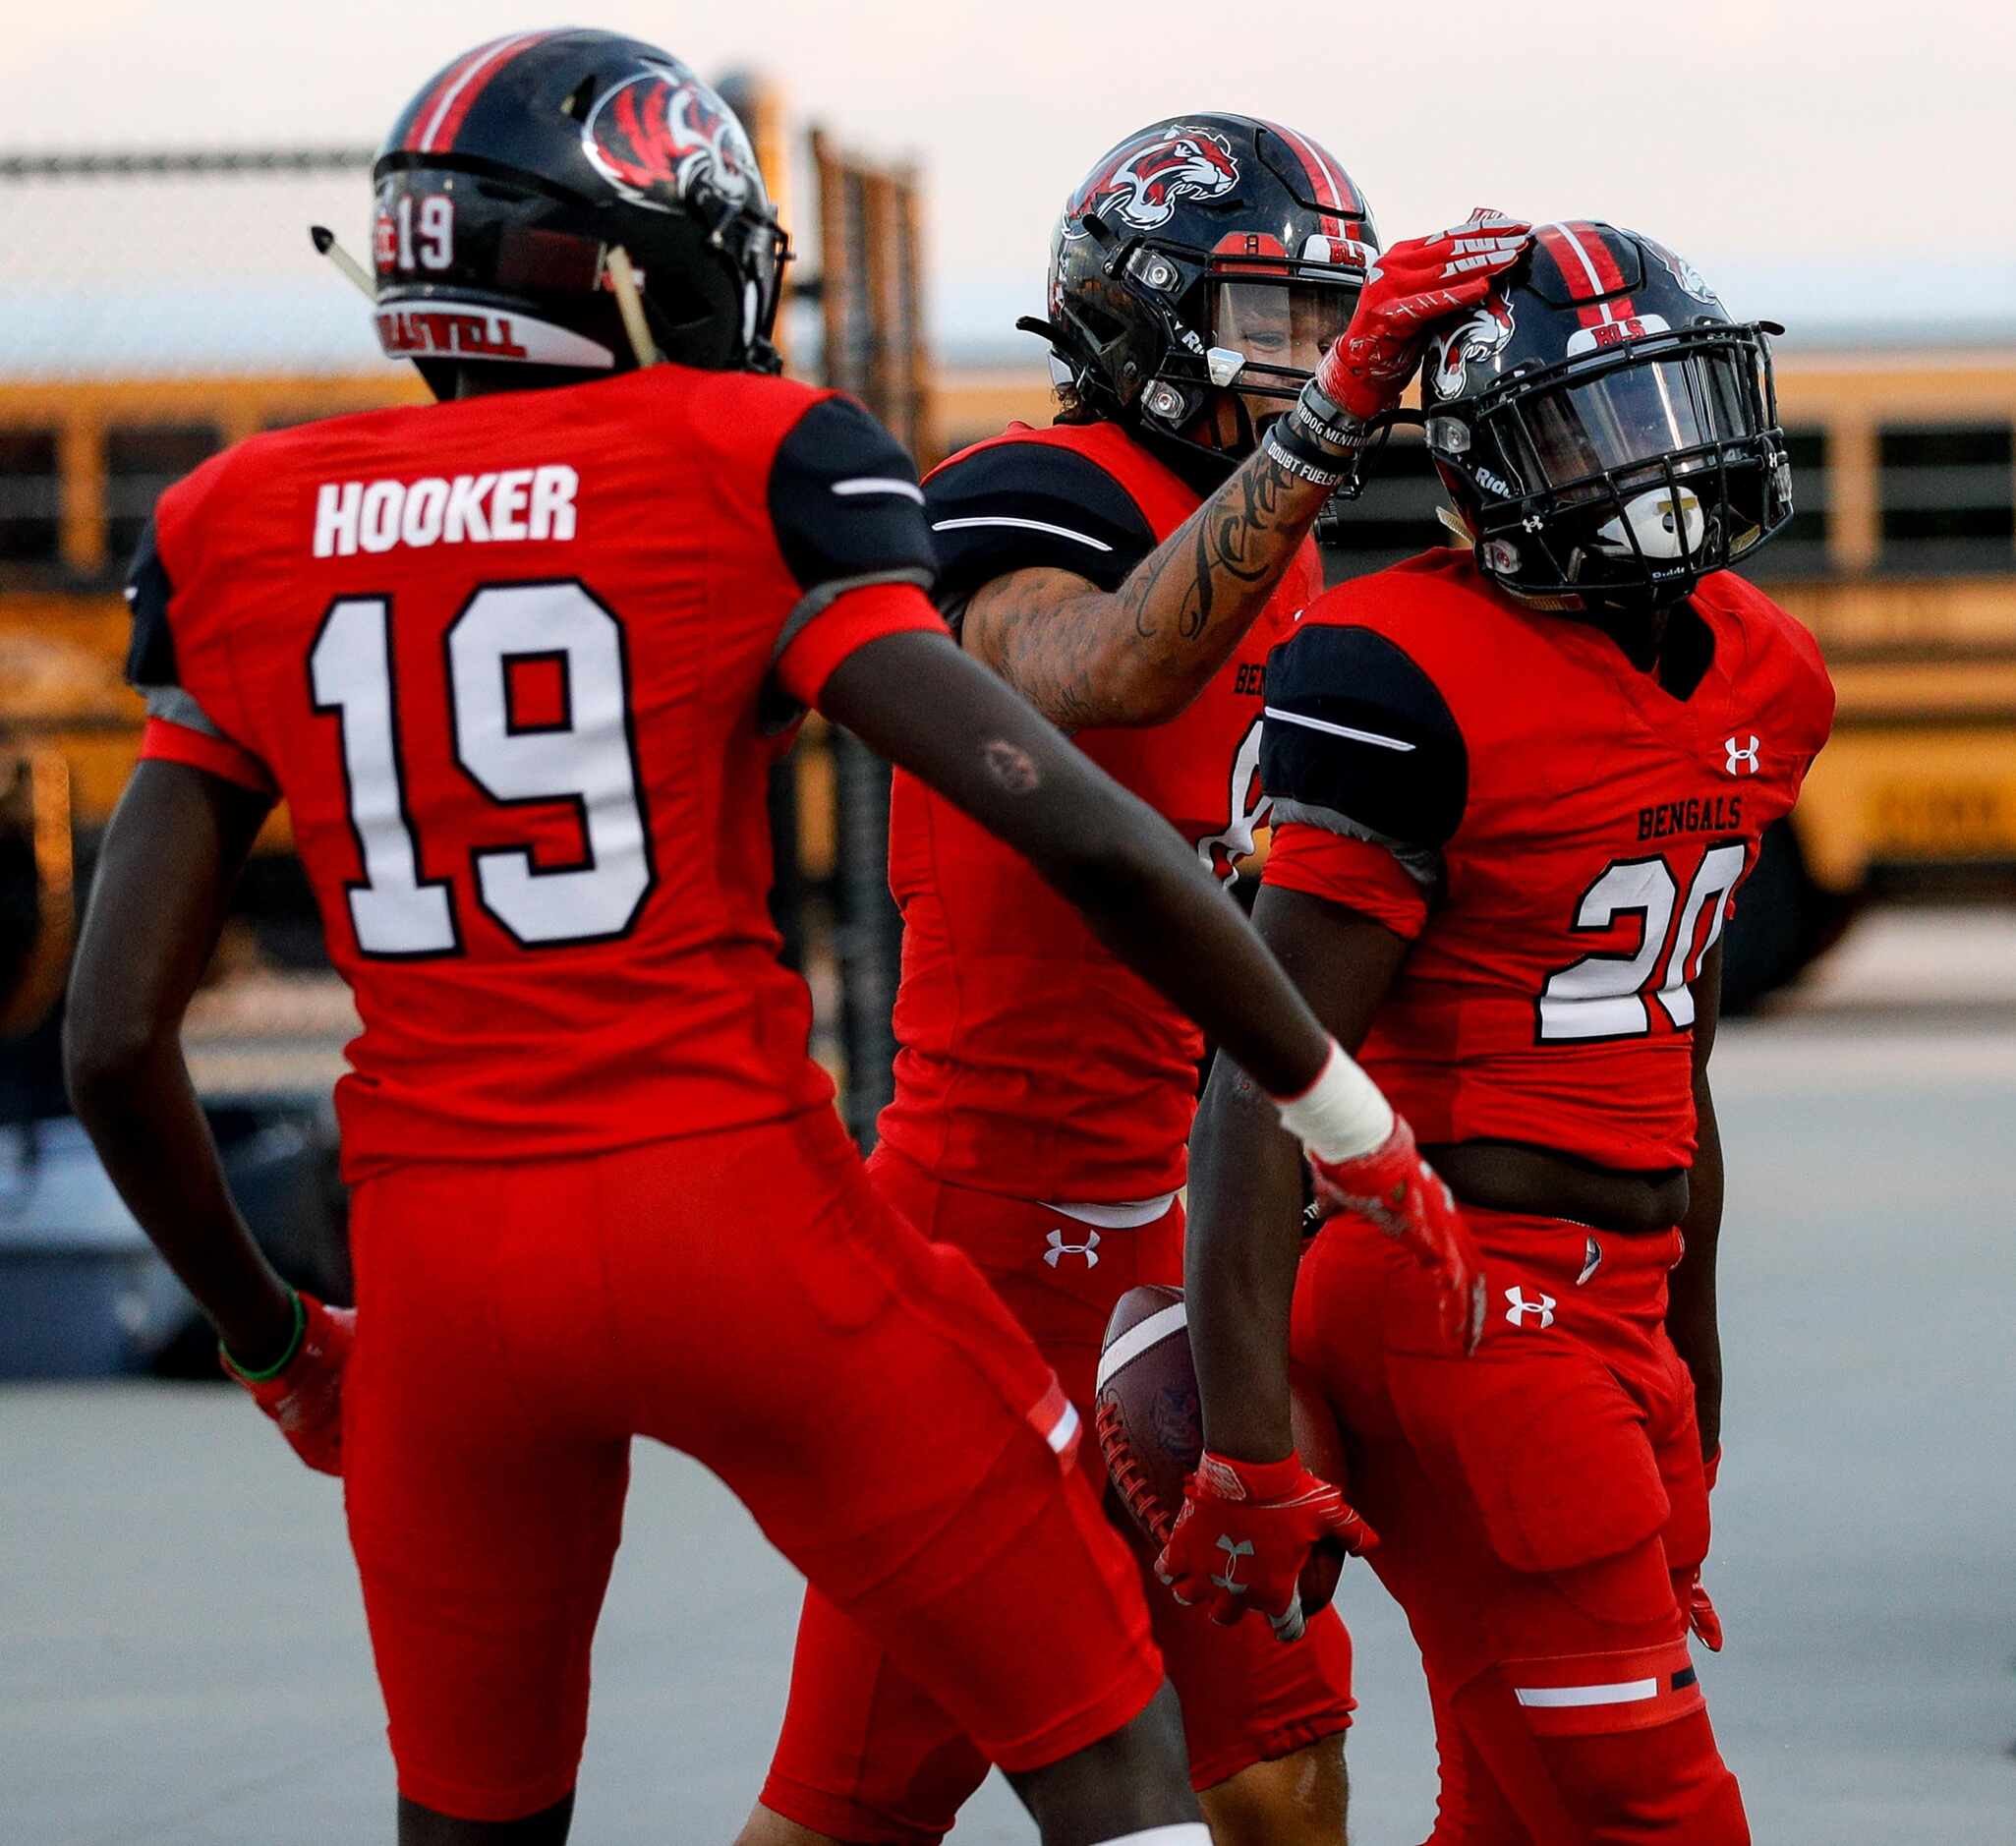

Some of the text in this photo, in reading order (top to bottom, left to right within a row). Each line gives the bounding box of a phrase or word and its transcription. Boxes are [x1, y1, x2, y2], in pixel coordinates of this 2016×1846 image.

[397, 194, 456, 272] 19
[1267, 441, 1301, 473] DOUBT
[1299, 464, 1337, 486] FUELS
[313, 464, 580, 558] HOOKER
[306, 577, 658, 962] 19
[1637, 795, 1743, 842] BENGALS
[1534, 840, 1747, 1045] 20
